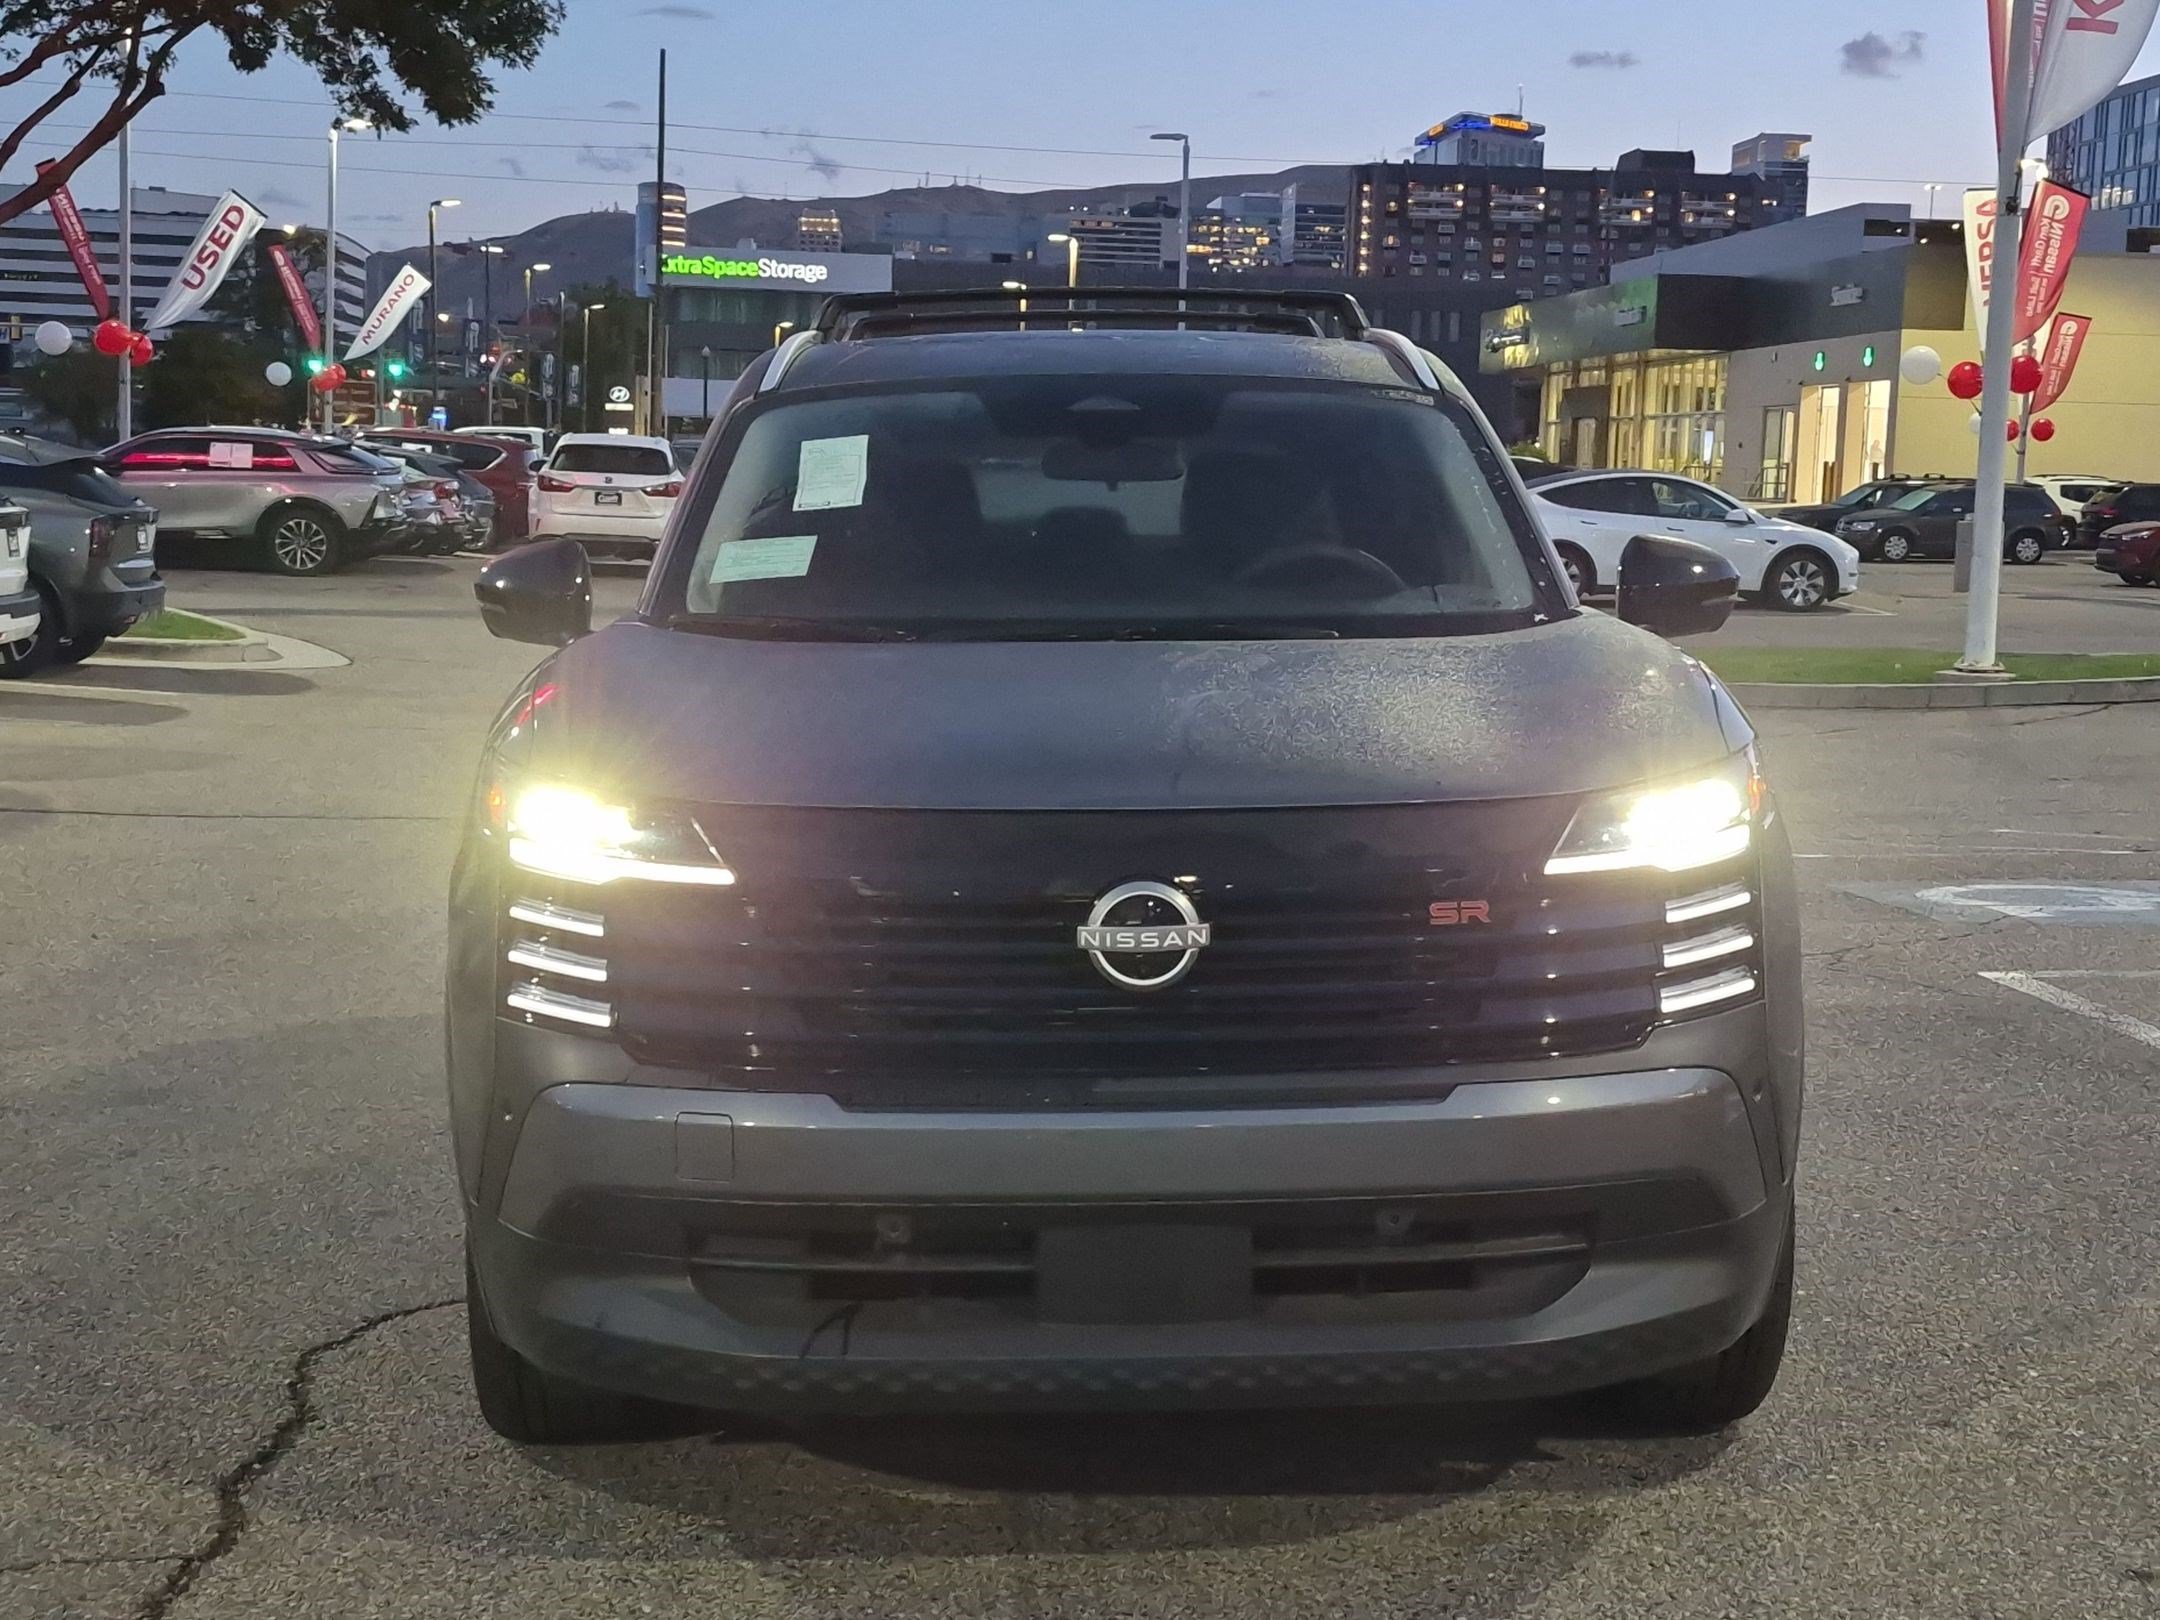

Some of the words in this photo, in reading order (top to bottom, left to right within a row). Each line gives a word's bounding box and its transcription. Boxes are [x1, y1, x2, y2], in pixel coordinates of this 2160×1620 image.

[181, 205, 245, 290] USED
[362, 273, 415, 346] MURANO
[1429, 900, 1491, 925] SR
[1080, 928, 1207, 948] NISSAN
